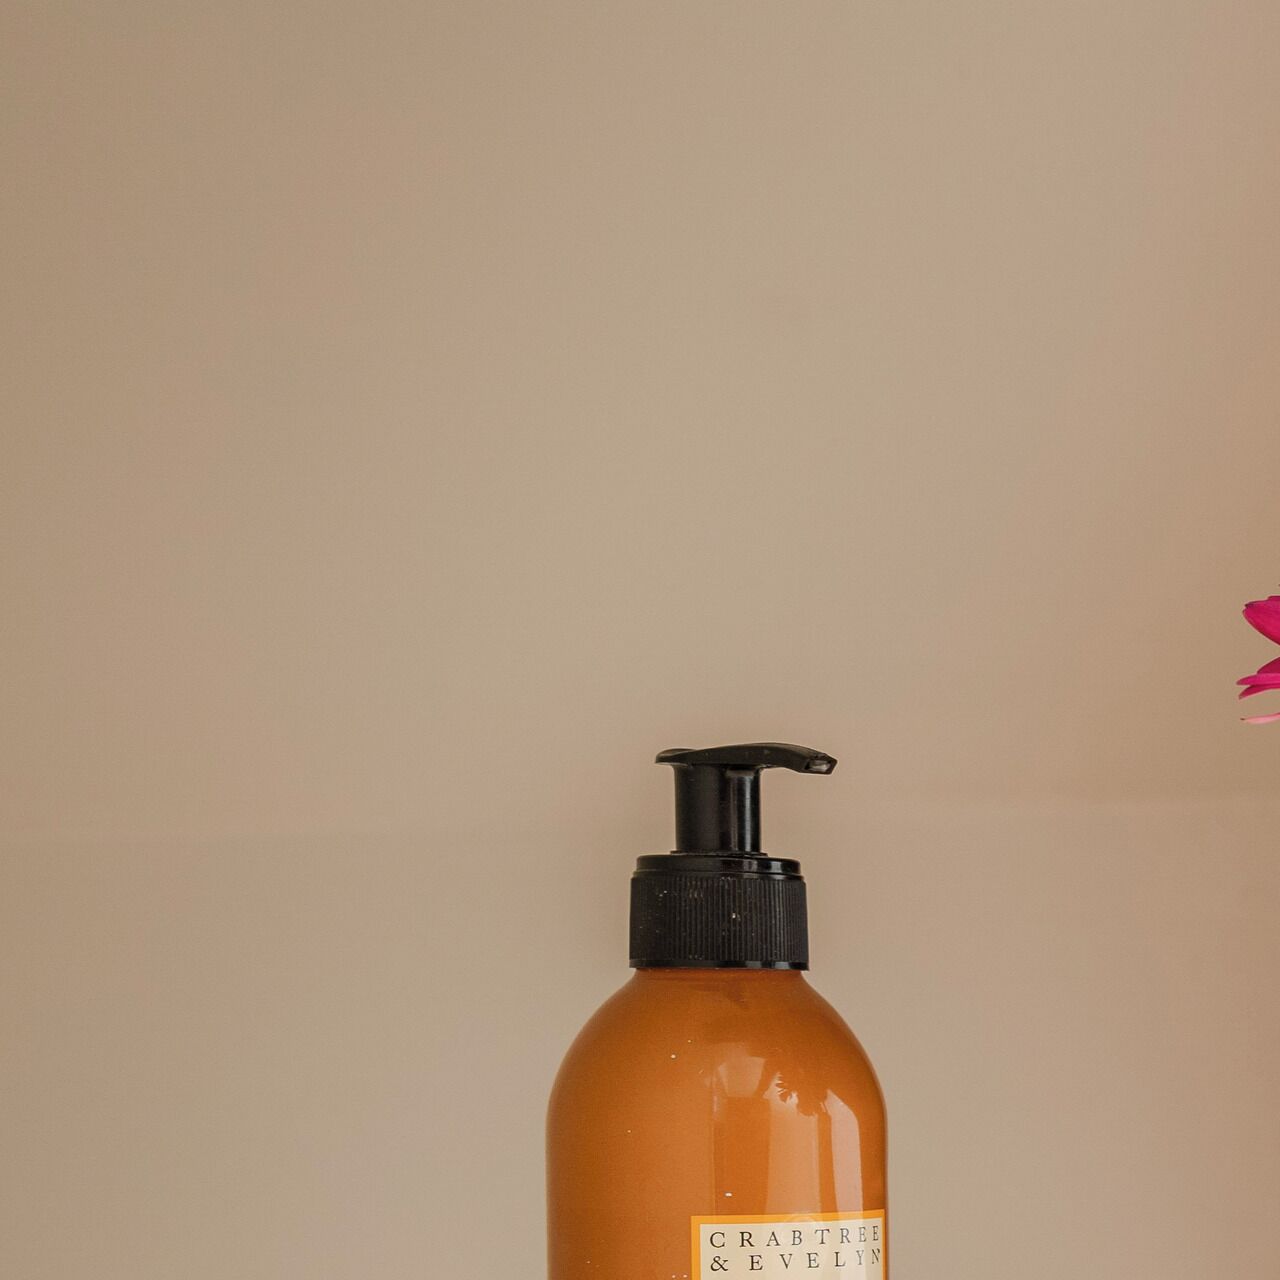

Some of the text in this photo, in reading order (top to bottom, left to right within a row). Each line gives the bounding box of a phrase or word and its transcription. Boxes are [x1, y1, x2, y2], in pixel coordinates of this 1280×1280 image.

[709, 1225, 880, 1248] CRABTREE
[710, 1248, 881, 1271] & EVELYN
